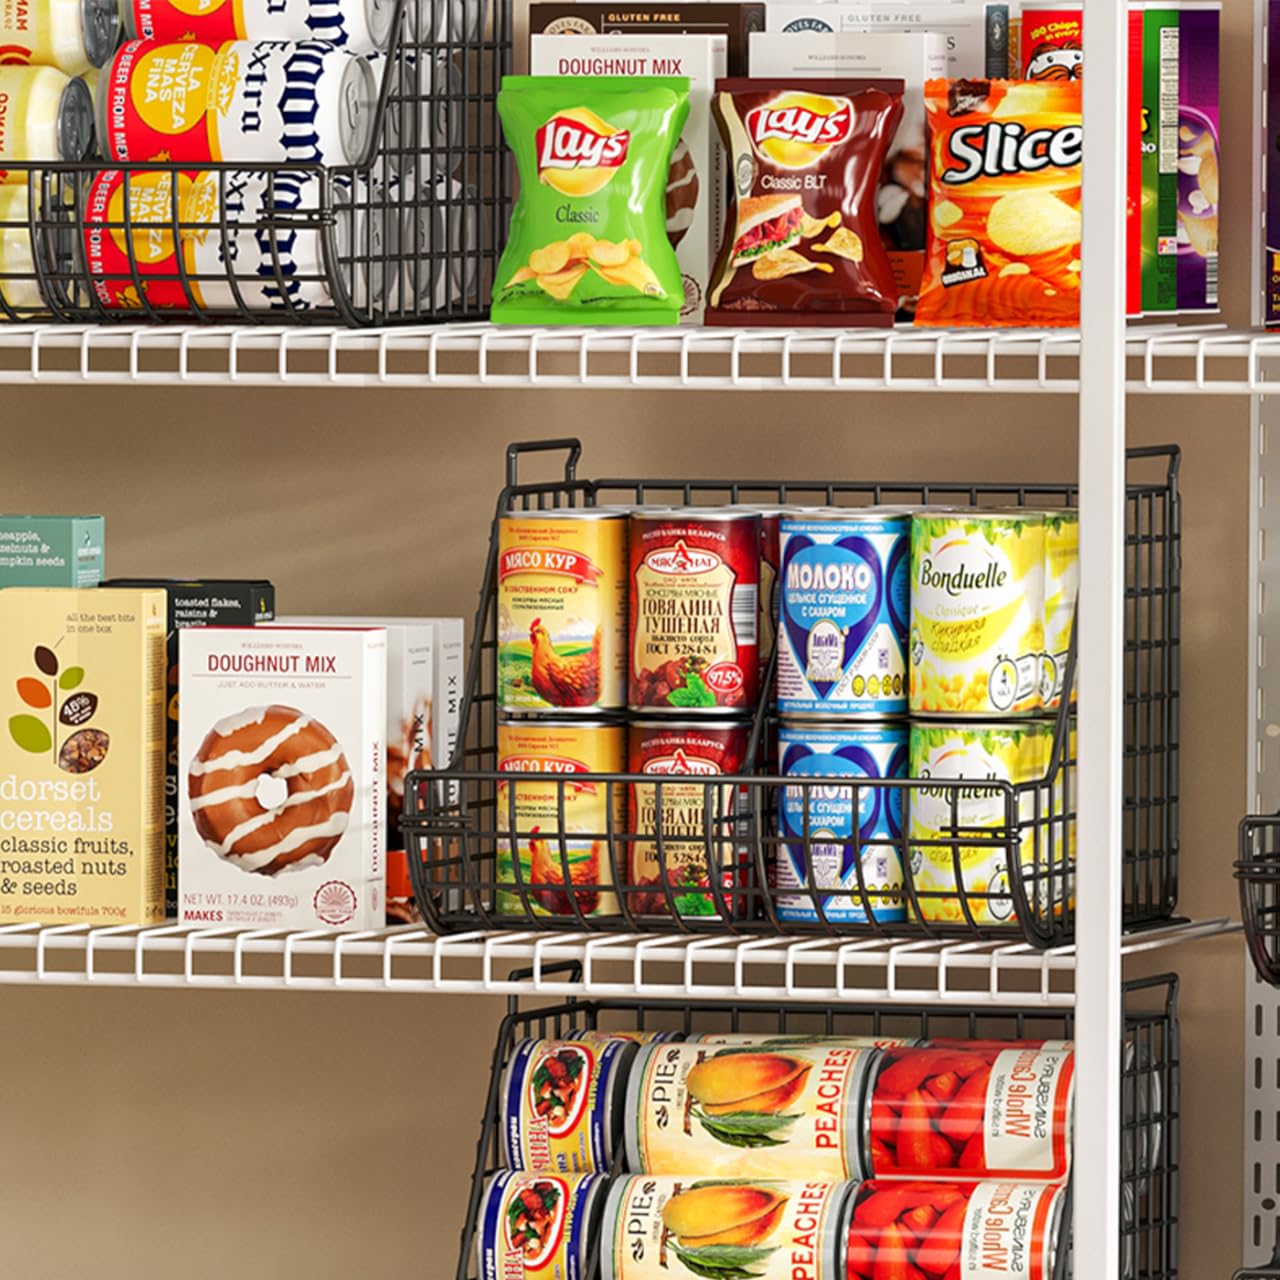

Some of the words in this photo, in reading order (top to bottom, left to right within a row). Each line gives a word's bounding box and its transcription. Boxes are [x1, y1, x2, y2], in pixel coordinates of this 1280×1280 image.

[608, 13, 650, 22] GLUTEN
[654, 13, 681, 22] FREE
[1048, 20, 1080, 36] Chips
[558, 58, 647, 76] DOUGHNUT
[652, 60, 682, 76] MIX
[144, 56, 163, 104] FINA
[159, 58, 180, 103] MAS
[171, 43, 200, 130] CERVEZA
[187, 66, 204, 92] LA
[943, 123, 1081, 183] Slice
[760, 175, 801, 190] Classic
[803, 176, 827, 189] BLT
[554, 204, 600, 223] Classic
[40, 543, 51, 553] &
[35, 555, 66, 566] seeds
[505, 552, 541, 570] МЯСО
[545, 553, 578, 571] КУР
[787, 560, 871, 592] МОЛОКО
[921, 556, 1008, 597] Bonduelle
[174, 597, 208, 607] toasted
[210, 597, 242, 609] flakes,
[641, 599, 723, 617] ГОВЯДИНА
[66, 612, 79, 622] all
[80, 612, 95, 622] the
[97, 612, 116, 622] best
[118, 612, 135, 622] bits
[174, 609, 207, 619] raisins
[78, 625, 93, 633] one
[95, 624, 112, 633] box
[645, 617, 721, 634] ТУШЕНАЯ
[208, 654, 300, 674] DOUGHNUT
[305, 655, 337, 674] MIX
[413, 713, 425, 754] MIX
[0, 774, 102, 803] dorset
[0, 806, 114, 833] cereals
[0, 836, 68, 854] classic
[73, 836, 135, 857] fruits,
[0, 858, 75, 875] roasted
[80, 859, 128, 876] nuts
[0, 877, 18, 895] &
[22, 878, 78, 896] seeds
[183, 893, 203, 905] NET
[206, 893, 225, 905] WT.
[227, 893, 247, 906] 17.4
[269, 893, 299, 908] (493g)
[0, 905, 13, 915] 15
[13, 905, 55, 917] glorious
[102, 905, 128, 918] 700g
[183, 909, 224, 921] MAKES
[815, 1050, 853, 1150] PEACHES
